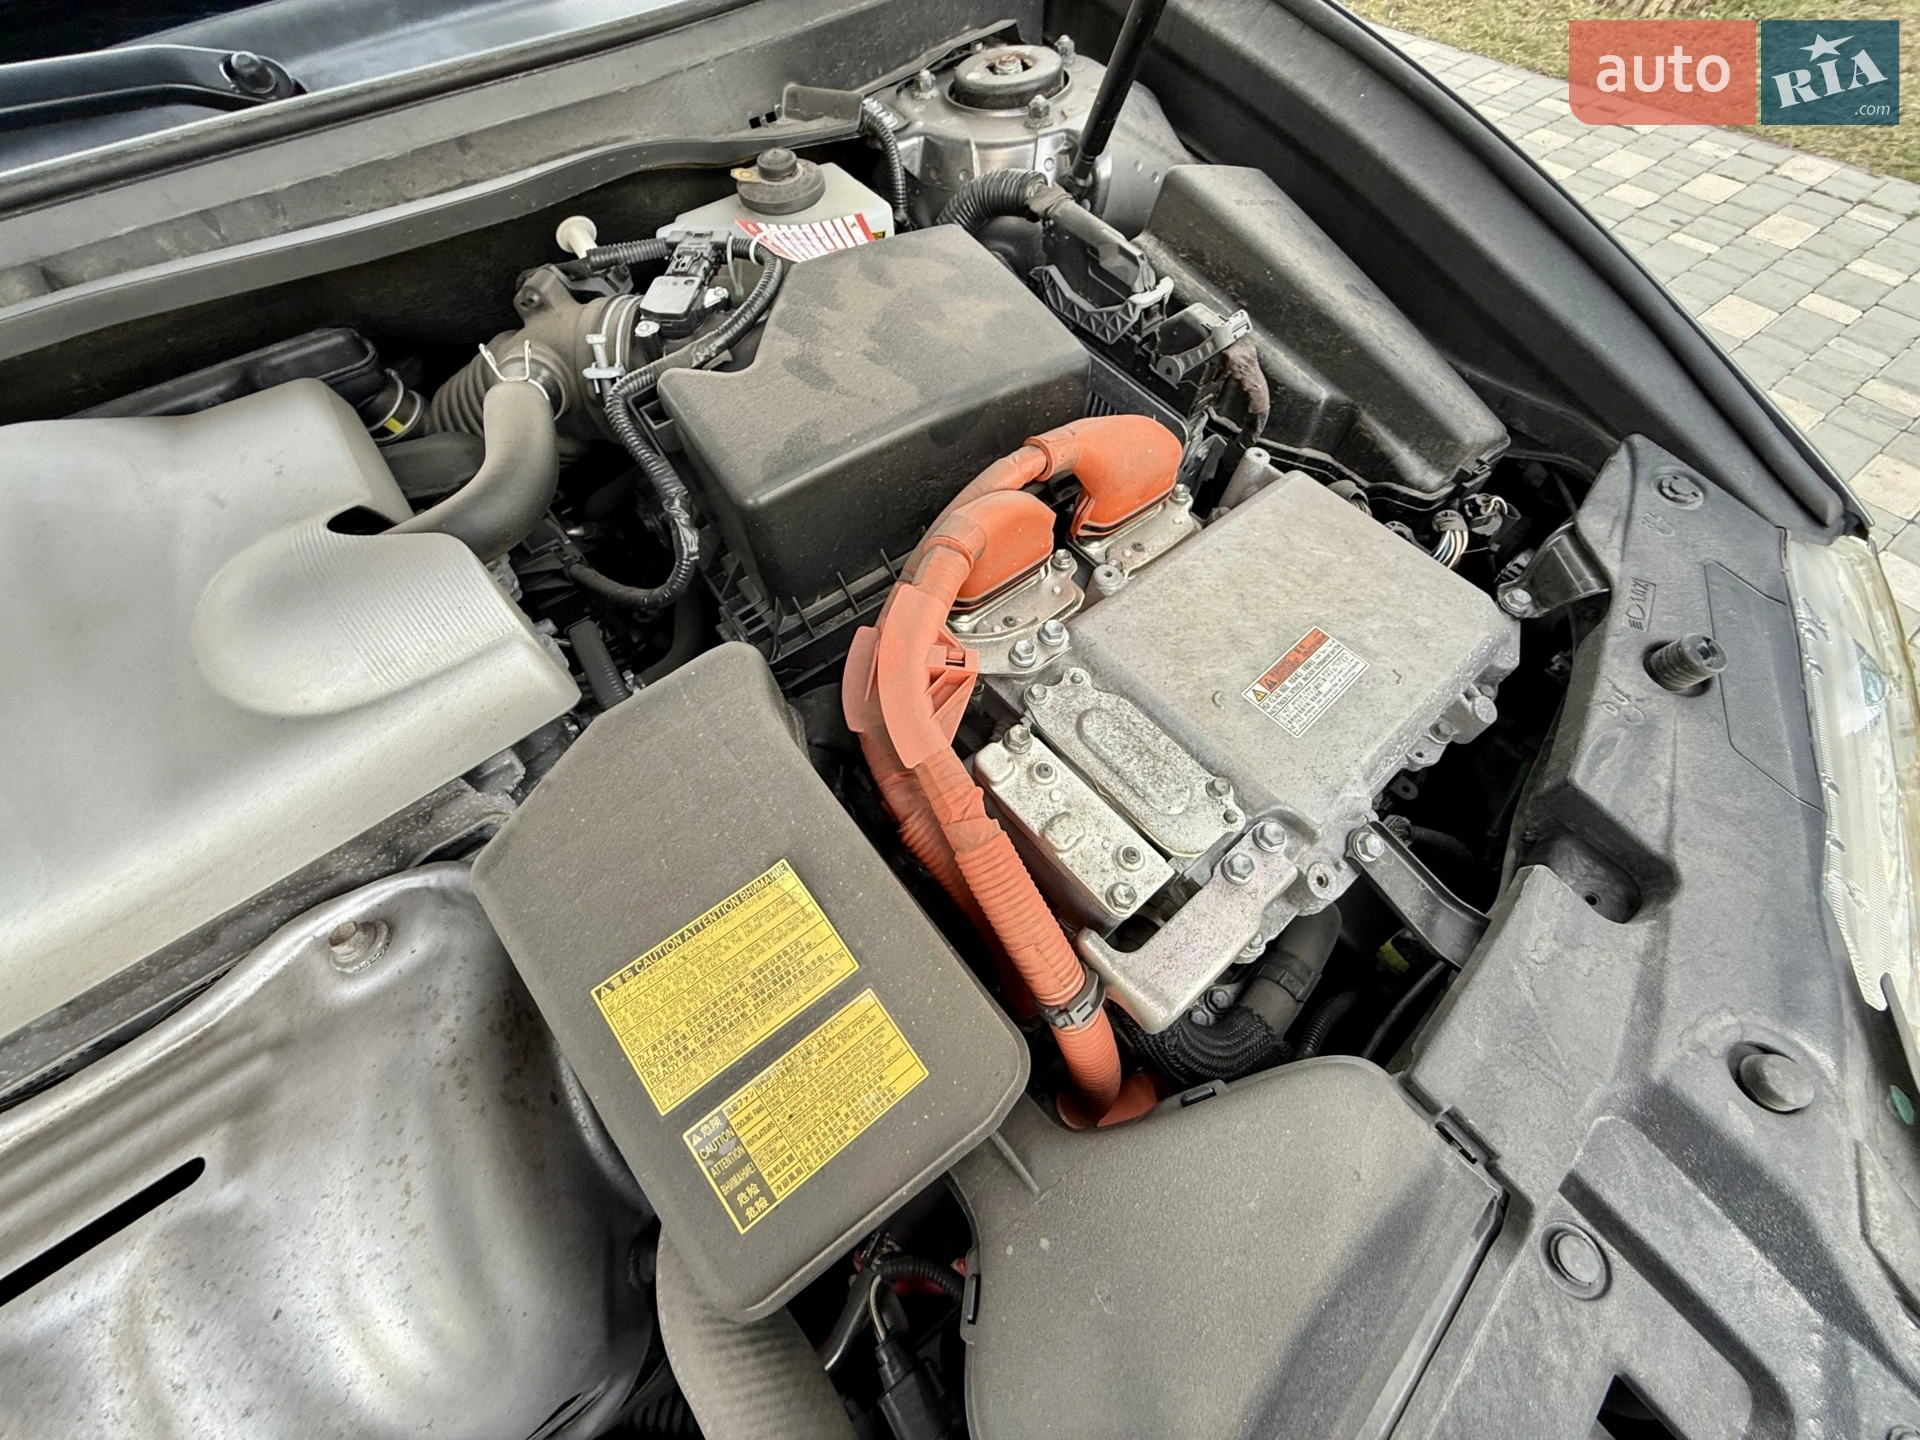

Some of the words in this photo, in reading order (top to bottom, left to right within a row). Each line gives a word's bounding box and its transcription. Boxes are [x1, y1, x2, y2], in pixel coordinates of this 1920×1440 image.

[632, 934, 683, 974] CAUTION
[681, 895, 741, 941] ATTENTION
[737, 863, 787, 901] ВНИМАНИЕ
[611, 1010, 622, 1021] TO
[622, 996, 643, 1014] AVOID
[665, 964, 689, 983] PLEASE
[688, 951, 706, 967] MAKE
[706, 940, 723, 955] SURE
[723, 929, 739, 943] THAT
[739, 920, 752, 932] THE
[751, 906, 771, 923] READY
[615, 1014, 629, 1027] THE
[628, 999, 651, 1018] METER
[650, 993, 659, 1003] IS
[658, 984, 672, 997] OFF
[671, 967, 695, 988] BEFORE
[722, 942, 731, 952] IN
[731, 933, 744, 946] THE
[743, 919, 764, 937] ENGINE
[618, 1021, 631, 1033] SEE
[659, 984, 684, 1004] MANUAL
[685, 973, 699, 986] FOR
[761, 1090, 770, 1101] TO
[769, 1077, 788, 1094] AVOID
[835, 1026, 852, 1041] KEEP
[850, 1012, 870, 1030] HANDS
[764, 1090, 781, 1106] AWAY
[780, 1076, 798, 1093] FROM
[813, 1051, 829, 1066] FANS
[828, 1041, 841, 1055] MAY
[840, 1028, 858, 1045] START
[857, 1022, 866, 1031] AT
[864, 1013, 878, 1025] ANY
[733, 1111, 754, 1131] COOLING
[751, 1102, 765, 1117] FANS
[743, 1119, 776, 1149] VENTILATEURS
[697, 1125, 736, 1161] CAUTION
[708, 1143, 746, 1178] ATTENTION
[734, 1179, 761, 1208] 危险
[742, 1193, 770, 1222] 危險
